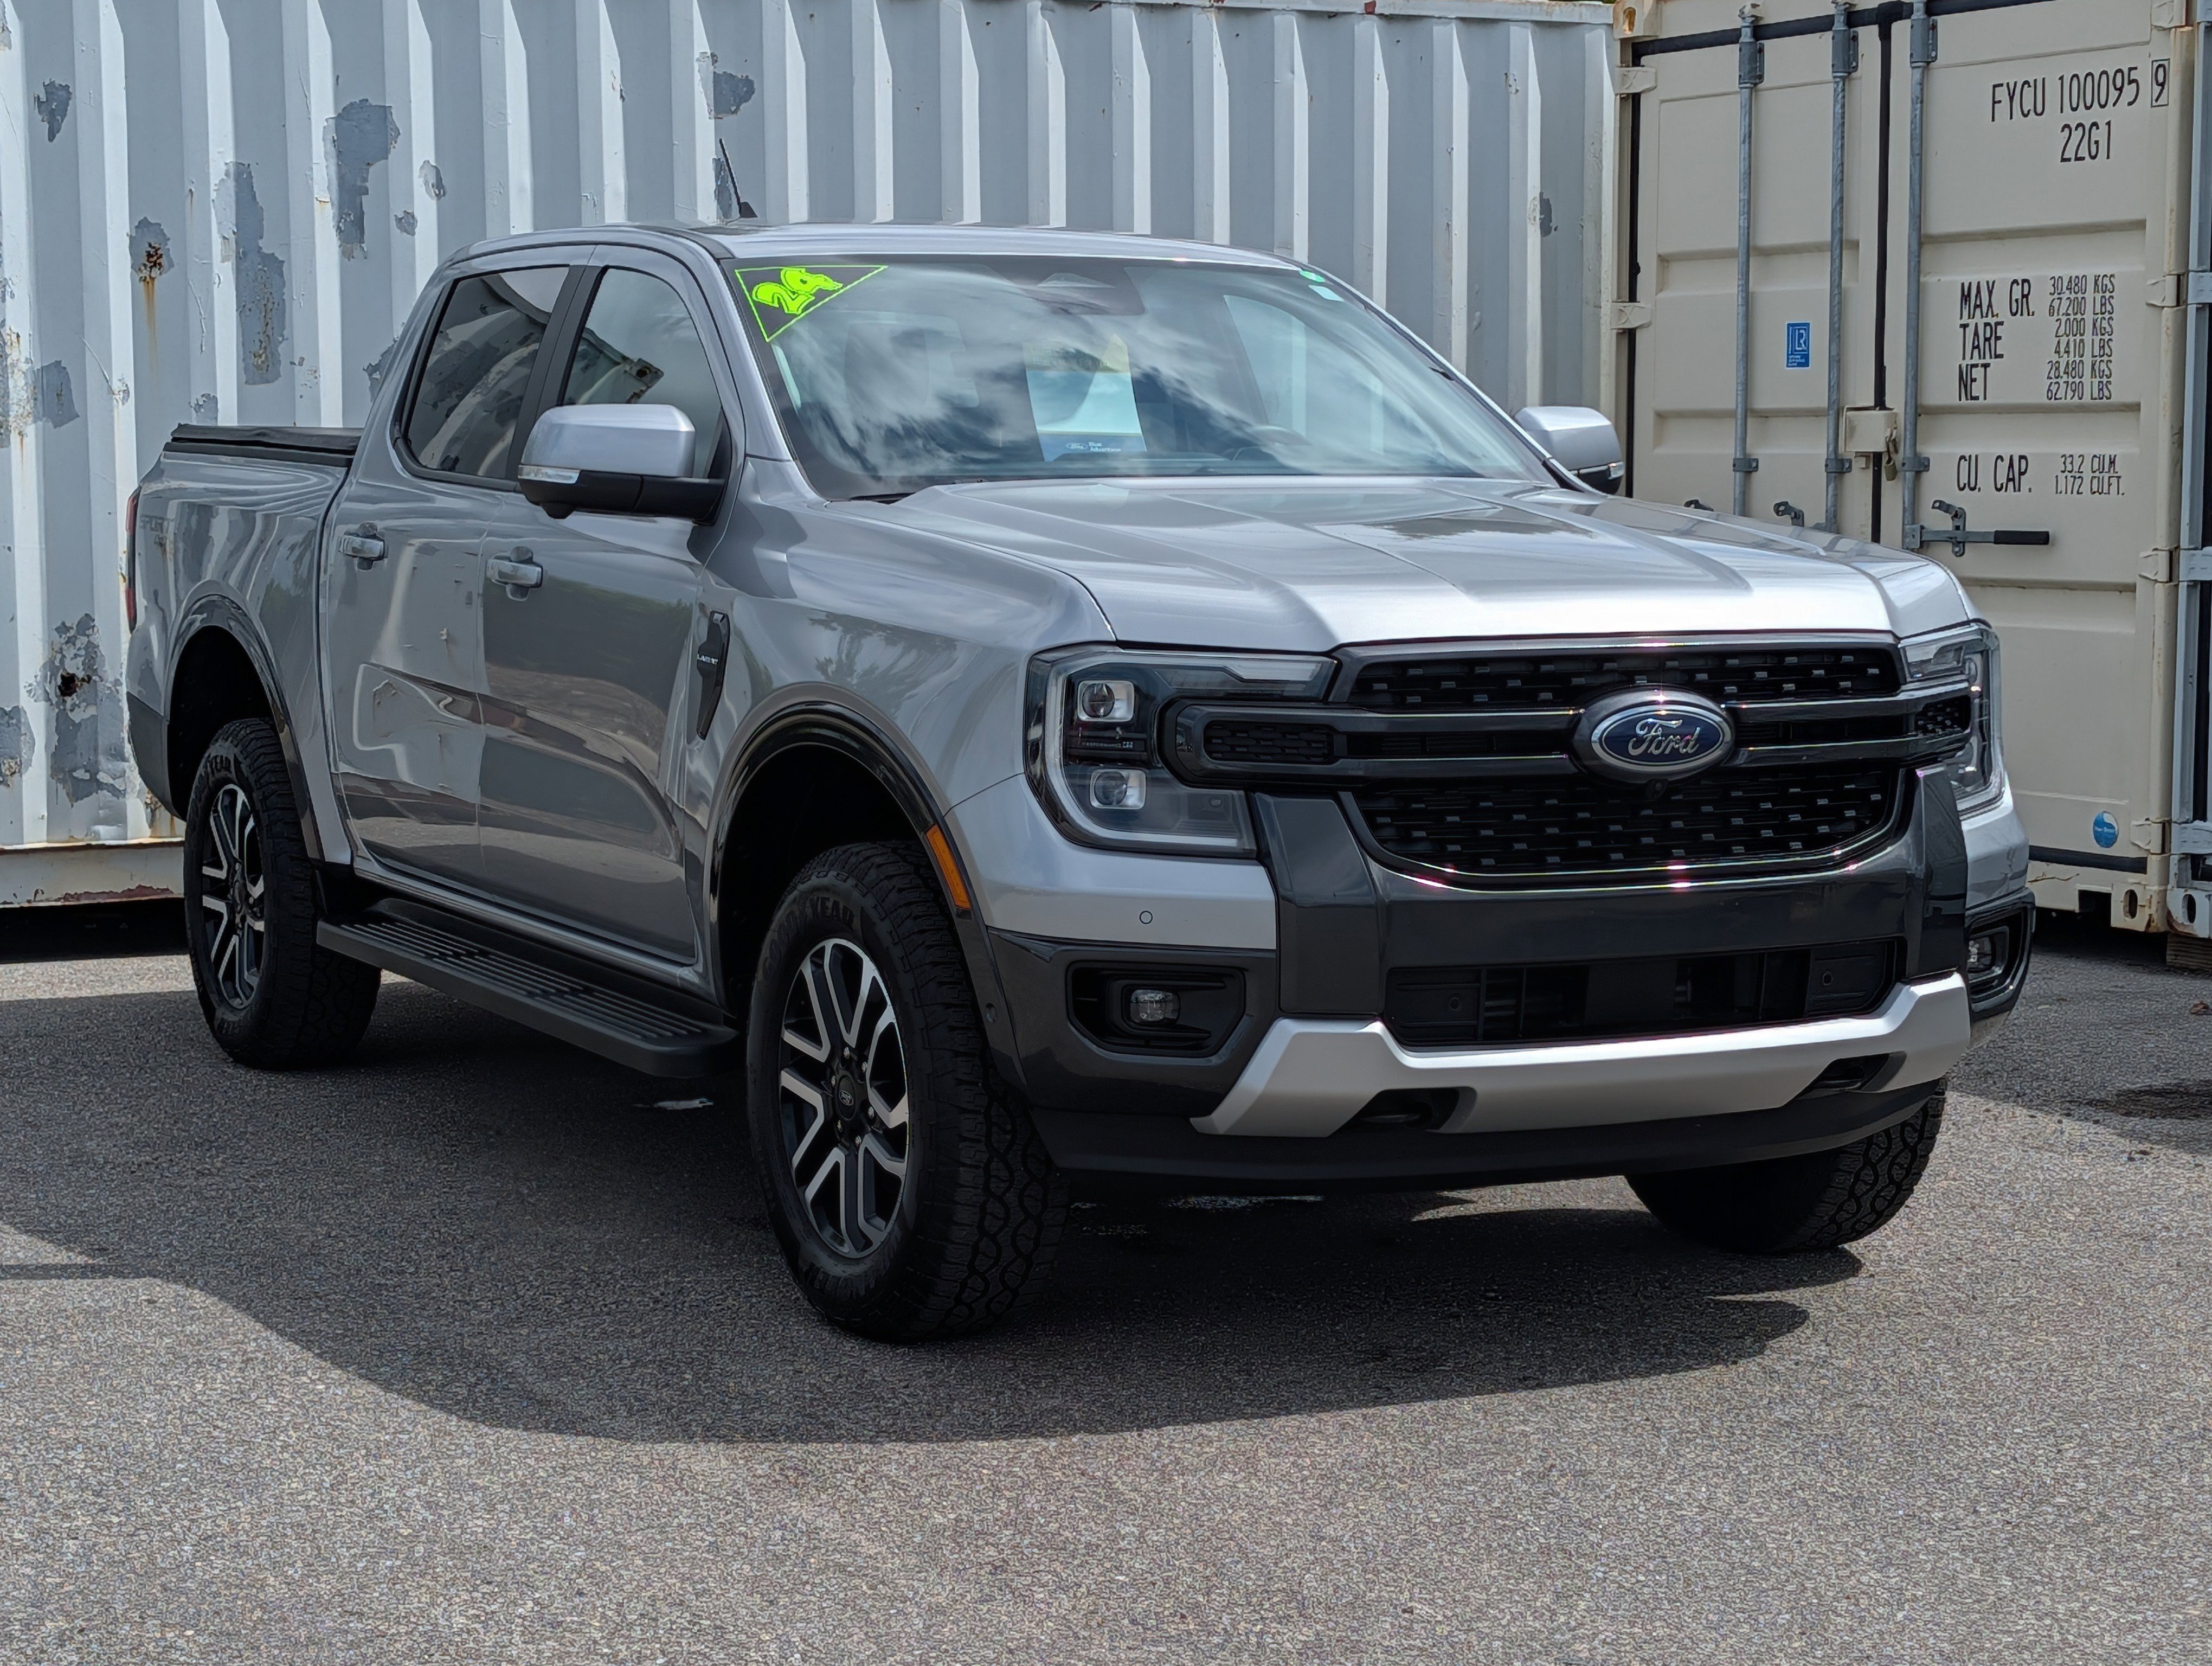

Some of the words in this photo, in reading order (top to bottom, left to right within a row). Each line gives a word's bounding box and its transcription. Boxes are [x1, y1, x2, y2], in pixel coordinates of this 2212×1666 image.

[1991, 77, 2046, 122] FYCU
[2059, 66, 2140, 113] 100095
[2154, 63, 2167, 103] 9
[2060, 120, 2112, 163] 22G1
[2094, 274, 2115, 294] KGS
[1959, 280, 1999, 320] MAX.
[2009, 278, 2035, 317] GR.
[2093, 295, 2114, 315] LBS
[2092, 316, 2114, 336] KGS
[1959, 321, 2004, 360] TARE
[2091, 338, 2113, 358] LBS
[1958, 363, 1991, 401] NET
[2091, 359, 2112, 379] KGS
[2090, 380, 2112, 400] LBS
[1957, 454, 1981, 492] CU.
[1994, 454, 2032, 492] CAP.
[2060, 454, 2085, 473] 33.2
[1628, 719, 1701, 756] Ford
